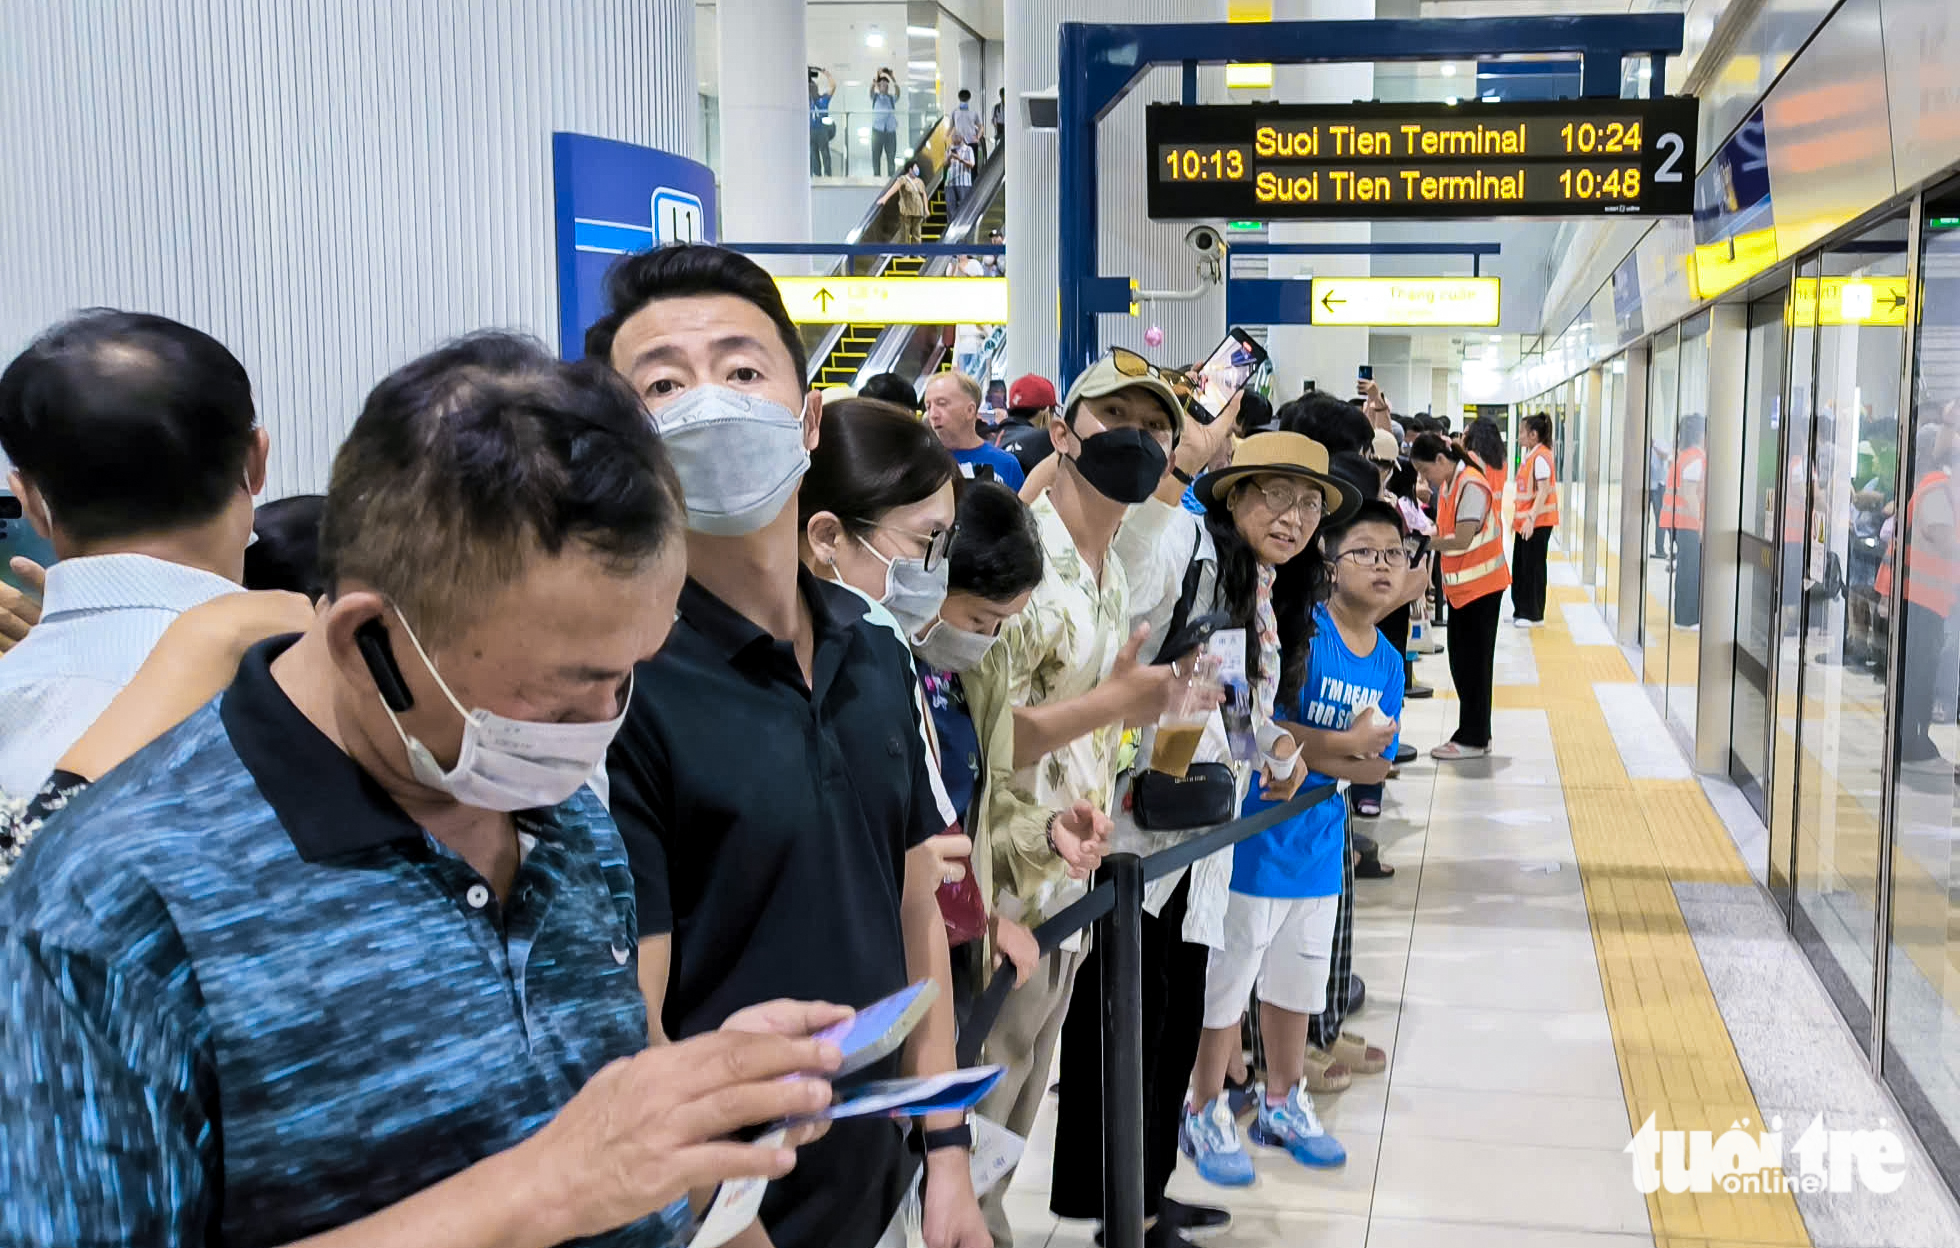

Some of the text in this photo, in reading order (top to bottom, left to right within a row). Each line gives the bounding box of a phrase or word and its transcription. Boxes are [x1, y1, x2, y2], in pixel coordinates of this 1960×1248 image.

[1255, 122, 1642, 157] Suoi Tien Terminal 10:24
[1166, 150, 1244, 180] 10:13
[1654, 132, 1684, 183] 2
[1255, 168, 1641, 202] Suoi Tien Terminal 10:48
[1320, 676, 1344, 702] I'M
[1307, 700, 1335, 727] FOR
